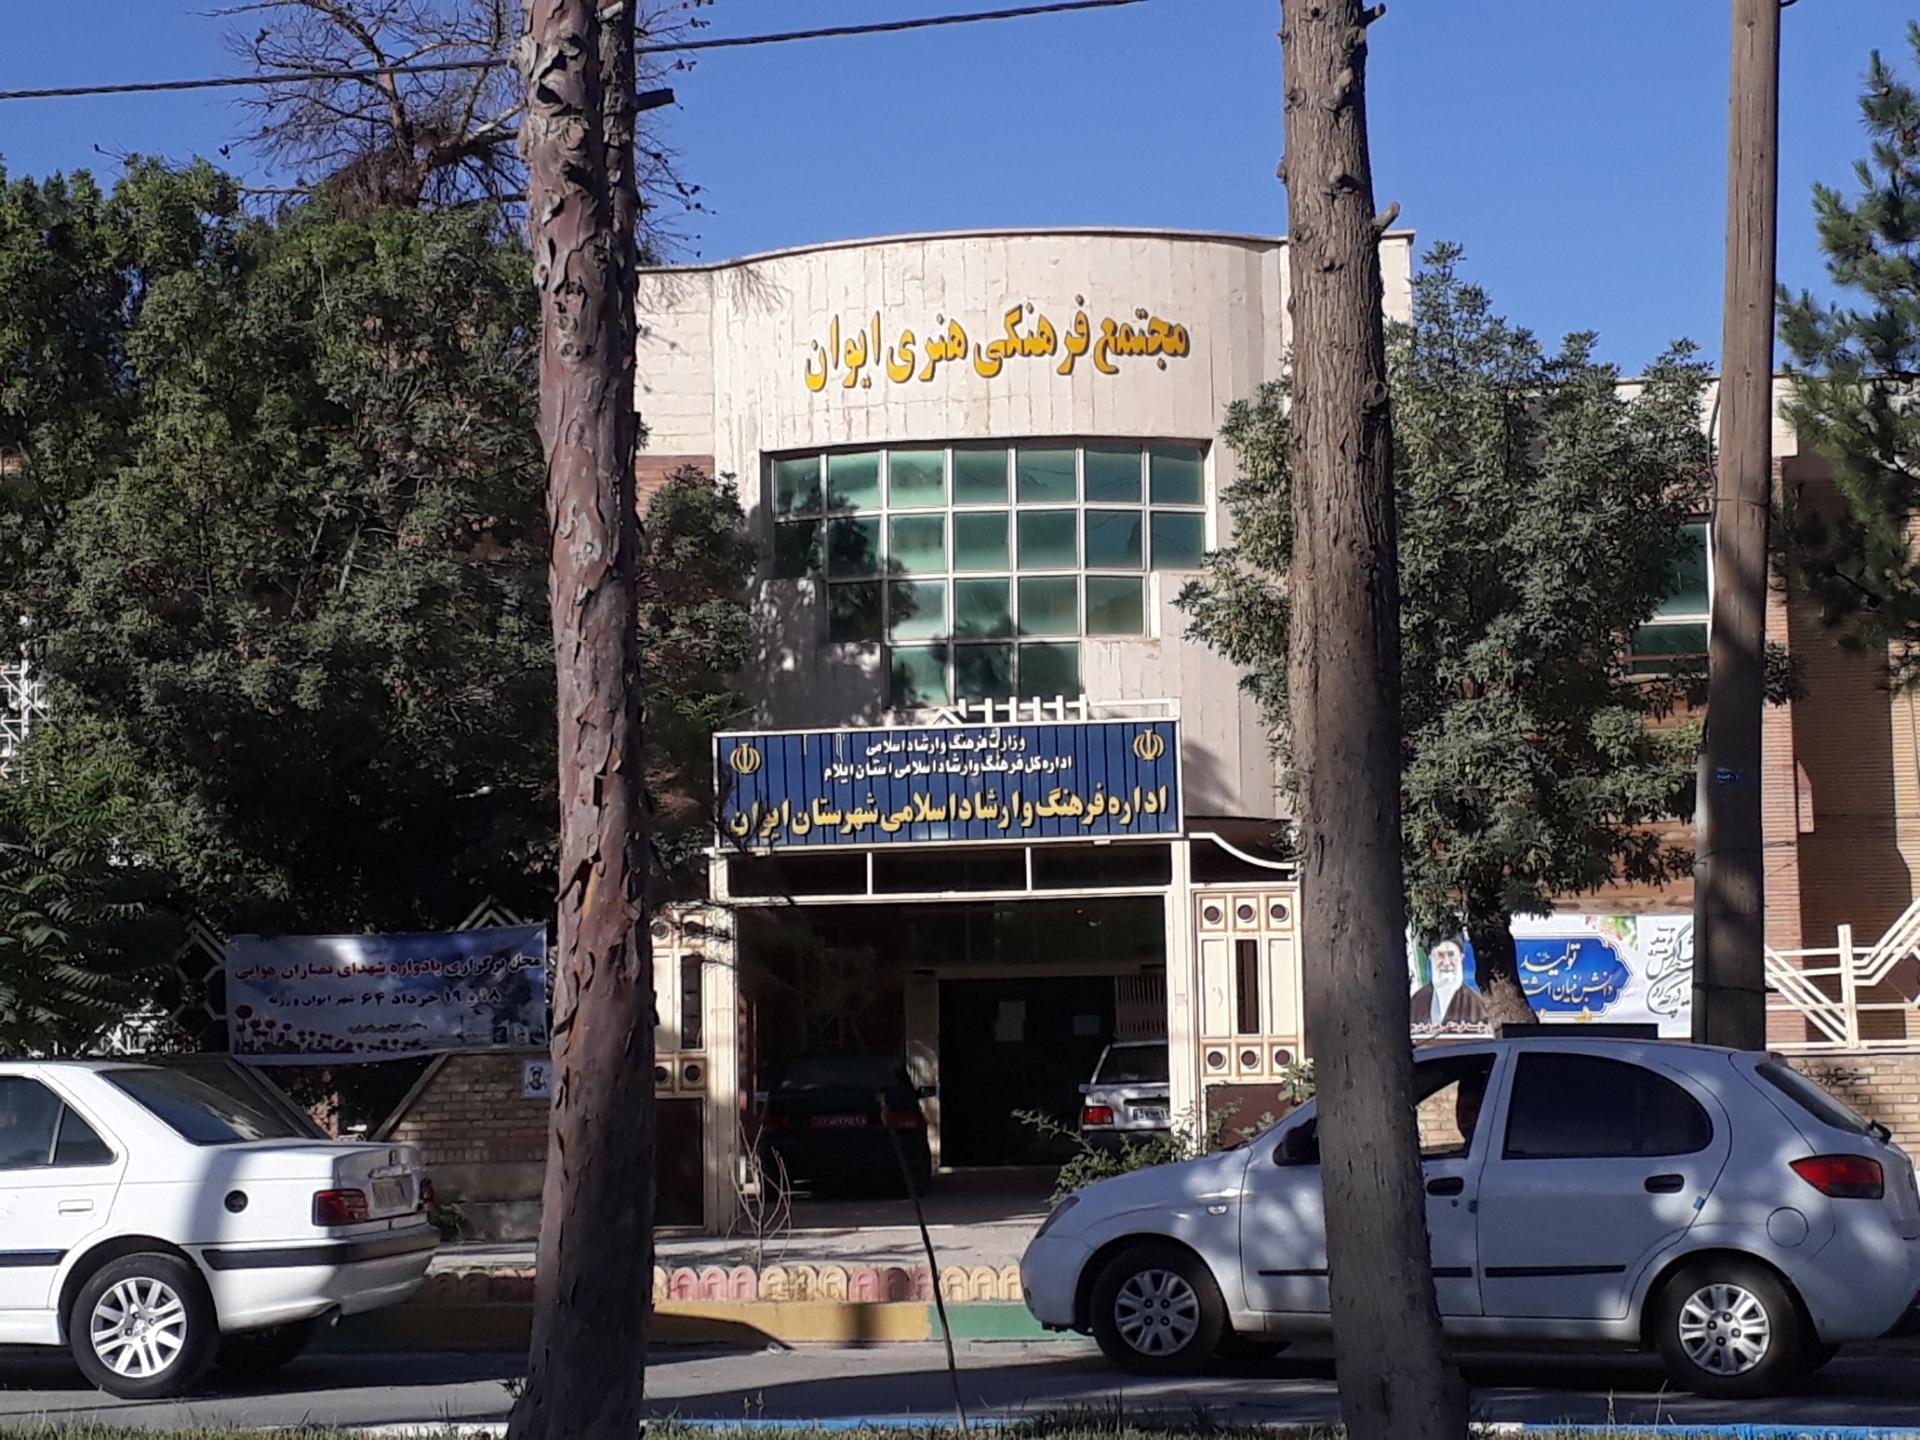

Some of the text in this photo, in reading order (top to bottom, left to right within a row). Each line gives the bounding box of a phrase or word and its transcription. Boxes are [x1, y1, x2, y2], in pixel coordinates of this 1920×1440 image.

[804, 310, 881, 392] ایوان
[886, 313, 968, 383] هنری
[1093, 307, 1191, 374] مجتمع
[866, 734, 1027, 756] وزارت فرهنگ و ارشاد اسلامی
[823, 753, 1073, 784] اداره کل فرهنگ و ارشاد اسلامی استان ایلام
[791, 791, 879, 836] شهرستان
[880, 791, 957, 833] اسلامی
[958, 789, 1020, 830] ارشاد
[1020, 801, 1034, 828] و
[1035, 781, 1106, 826] فرهنگ
[1107, 785, 1168, 826] اداره
[234, 952, 543, 981] محل برگزاری یادواره شهدای بمباران هوایی
[1520, 941, 1583, 977] تولید
[360, 992, 386, 1007] ۶۴
[391, 990, 439, 1007] خرداد
